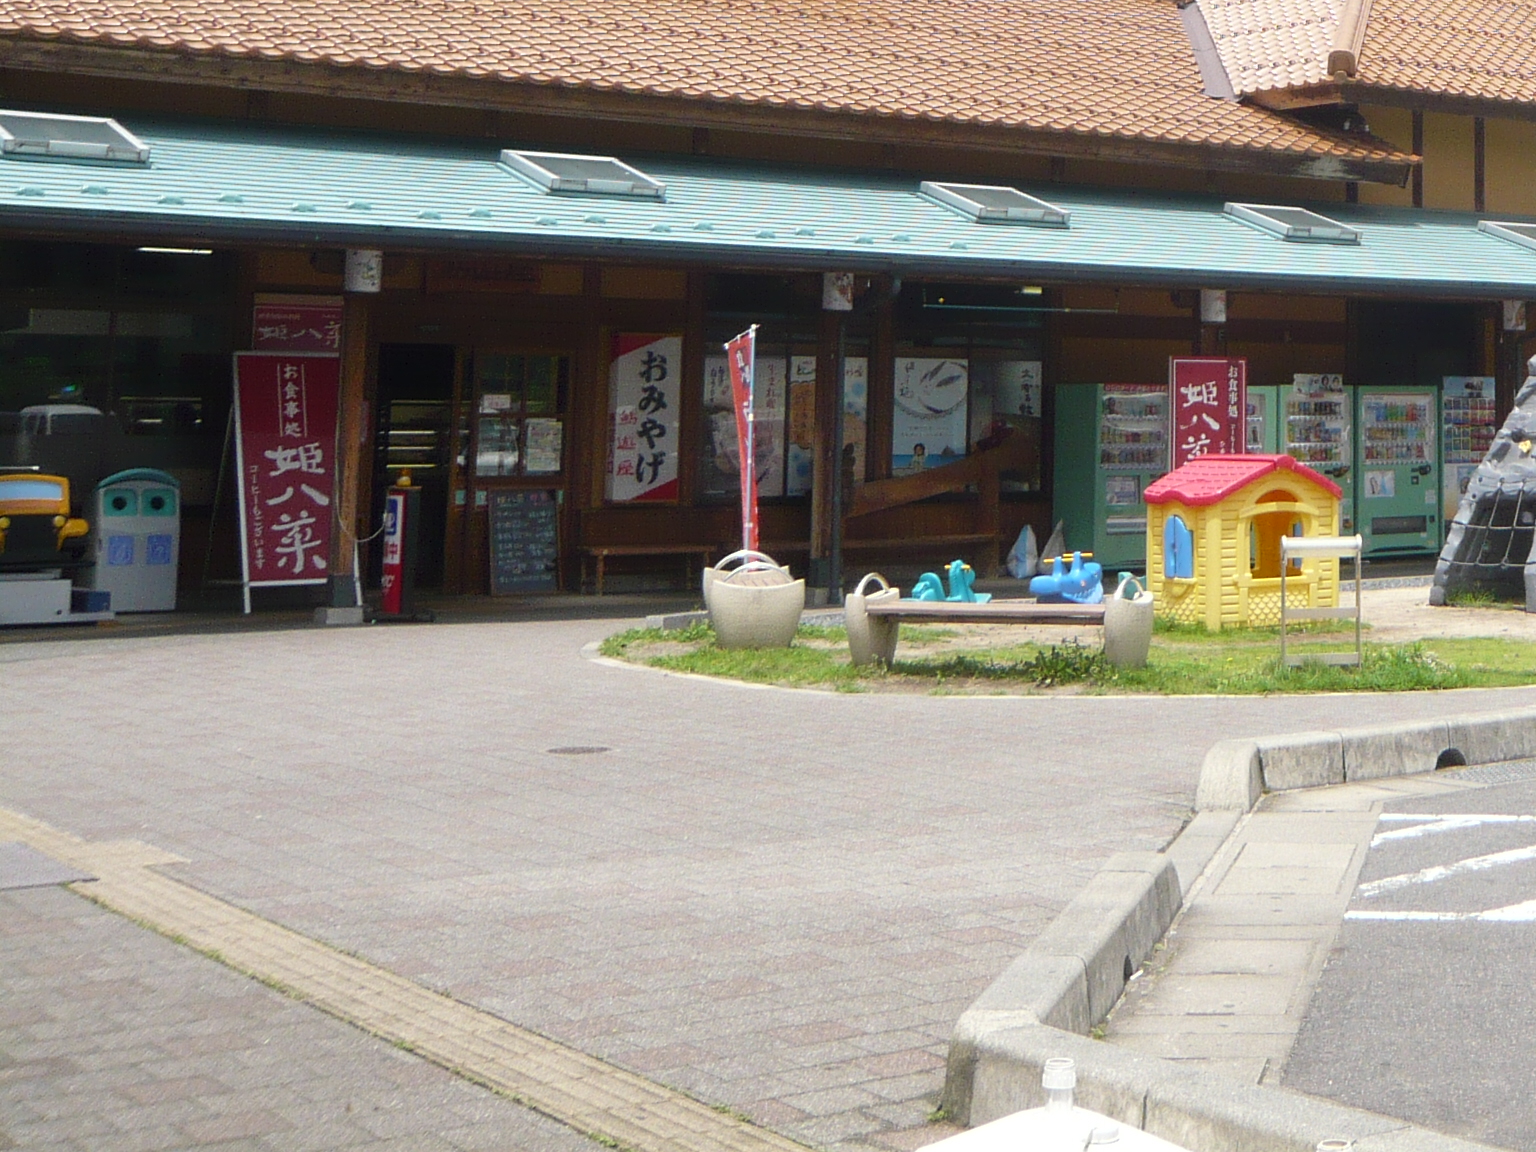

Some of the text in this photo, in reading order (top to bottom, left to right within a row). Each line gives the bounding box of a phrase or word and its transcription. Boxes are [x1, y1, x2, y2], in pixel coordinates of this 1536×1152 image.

[283, 363, 302, 438] お食事処
[635, 350, 668, 485] おみやげ
[1227, 364, 1239, 418] お食事処
